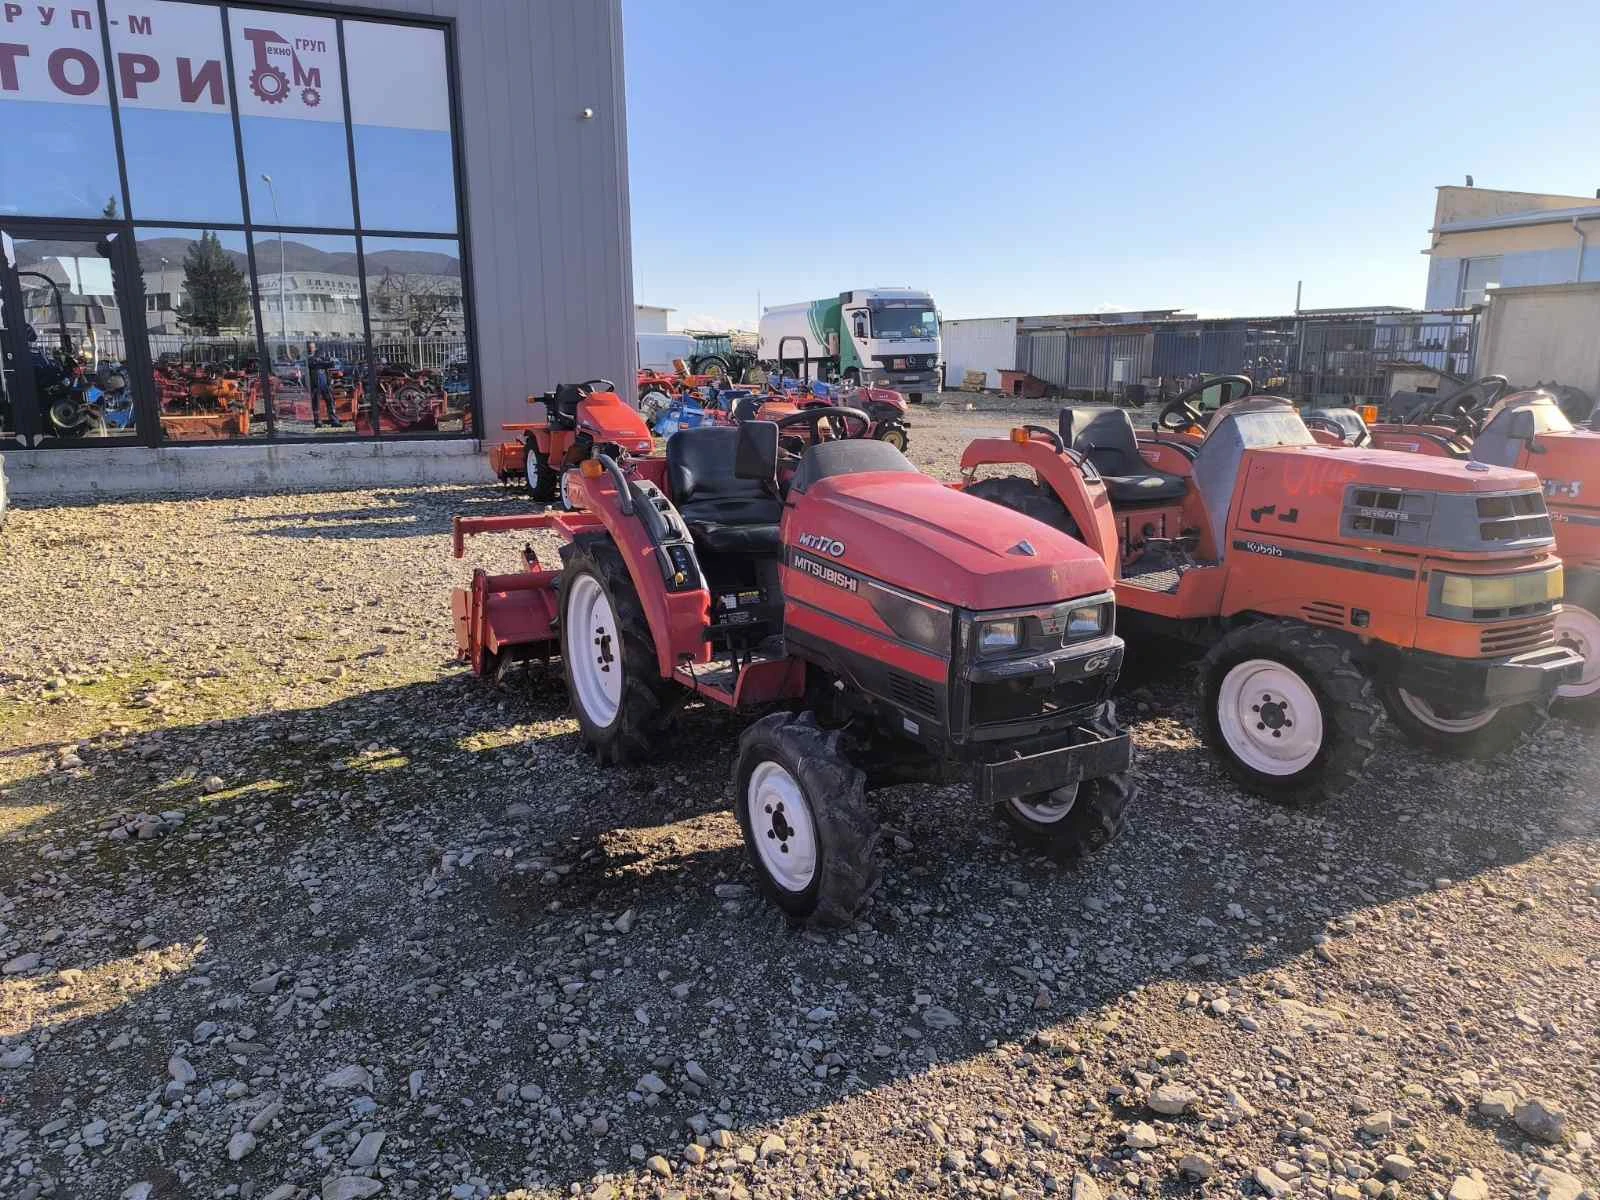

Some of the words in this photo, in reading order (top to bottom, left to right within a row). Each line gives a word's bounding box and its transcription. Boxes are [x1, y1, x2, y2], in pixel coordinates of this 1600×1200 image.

[295, 38, 326, 53] ГРУП
[0, 42, 226, 105] ТОРИ
[799, 532, 845, 557] MT170
[1247, 541, 1283, 557] Kubota
[794, 555, 857, 592] MITSUBISHI
